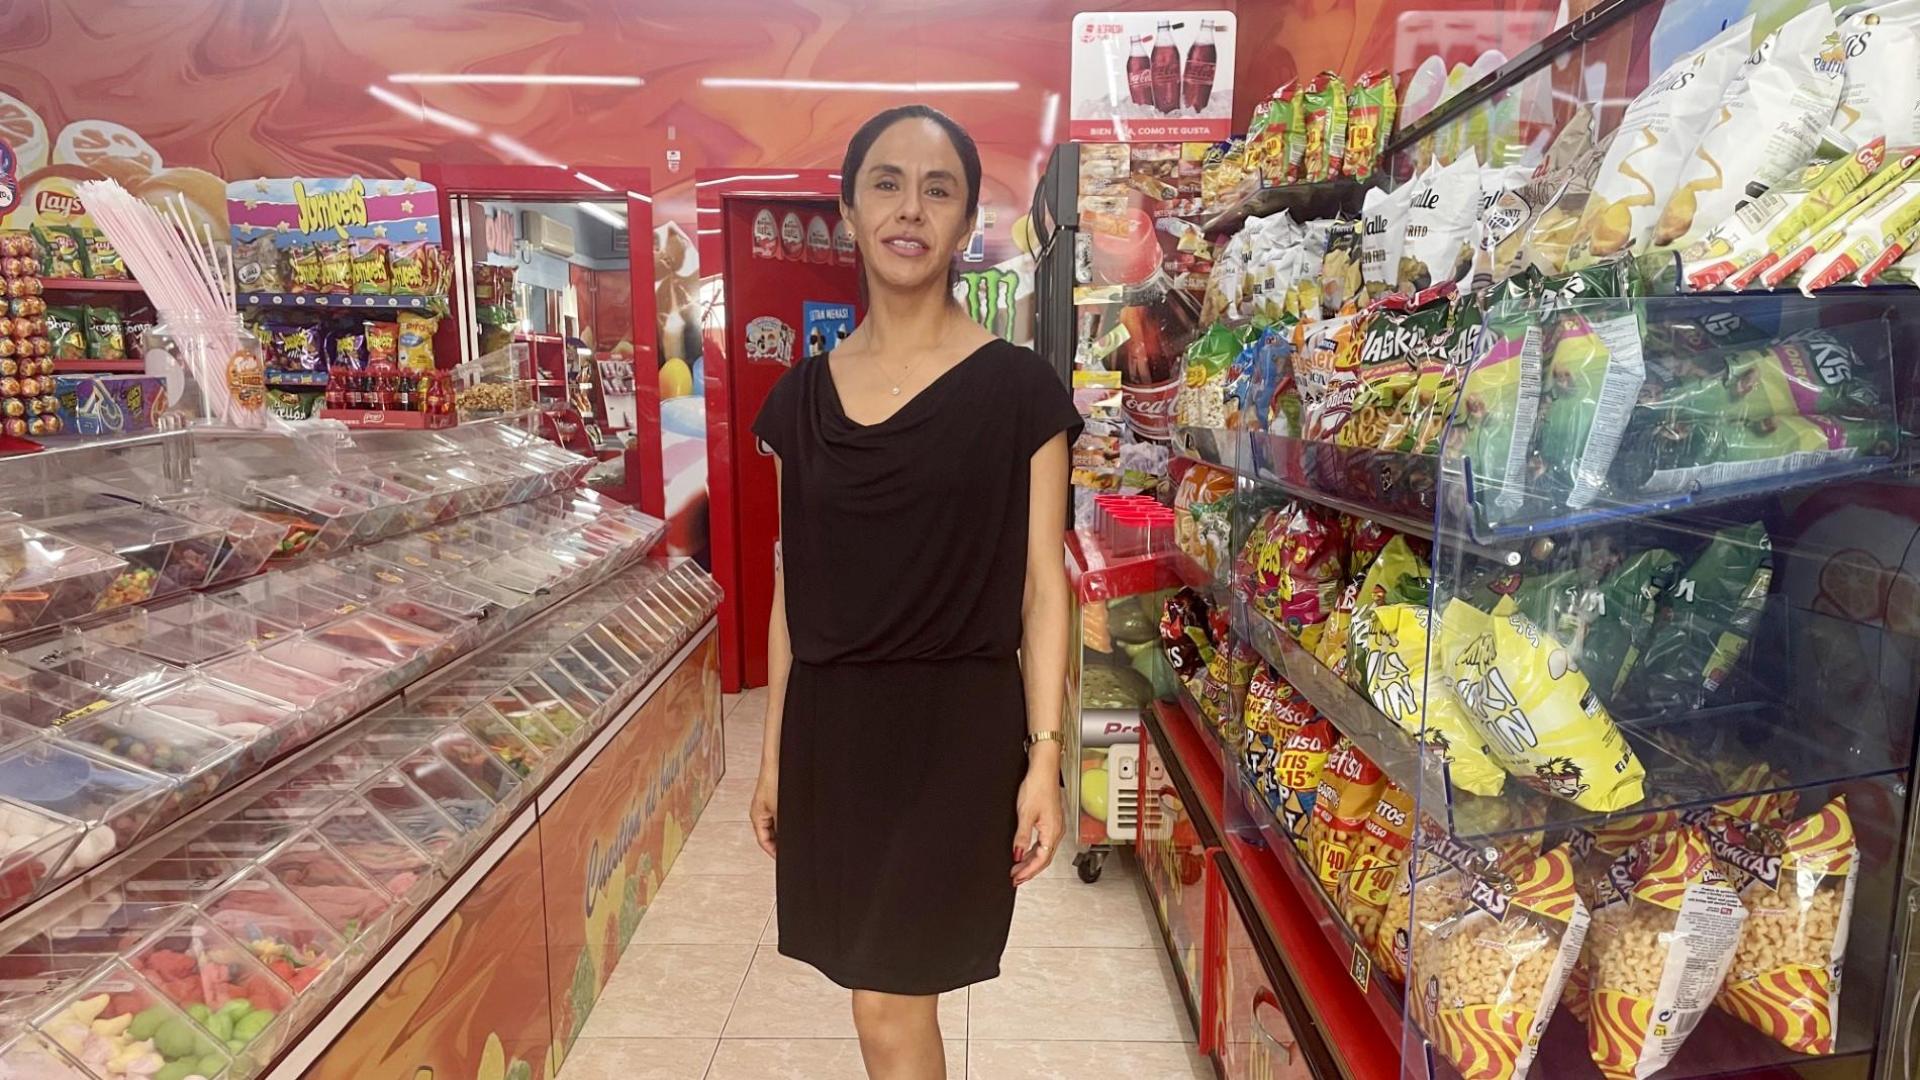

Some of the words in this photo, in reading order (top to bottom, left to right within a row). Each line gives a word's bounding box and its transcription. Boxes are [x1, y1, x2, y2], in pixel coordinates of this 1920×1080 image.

[1090, 127, 1111, 136] BIEN
[1135, 127, 1165, 136] COMO
[1167, 127, 1179, 136] TE
[1181, 127, 1211, 136] GUSTA
[292, 179, 368, 239] Jumpers
